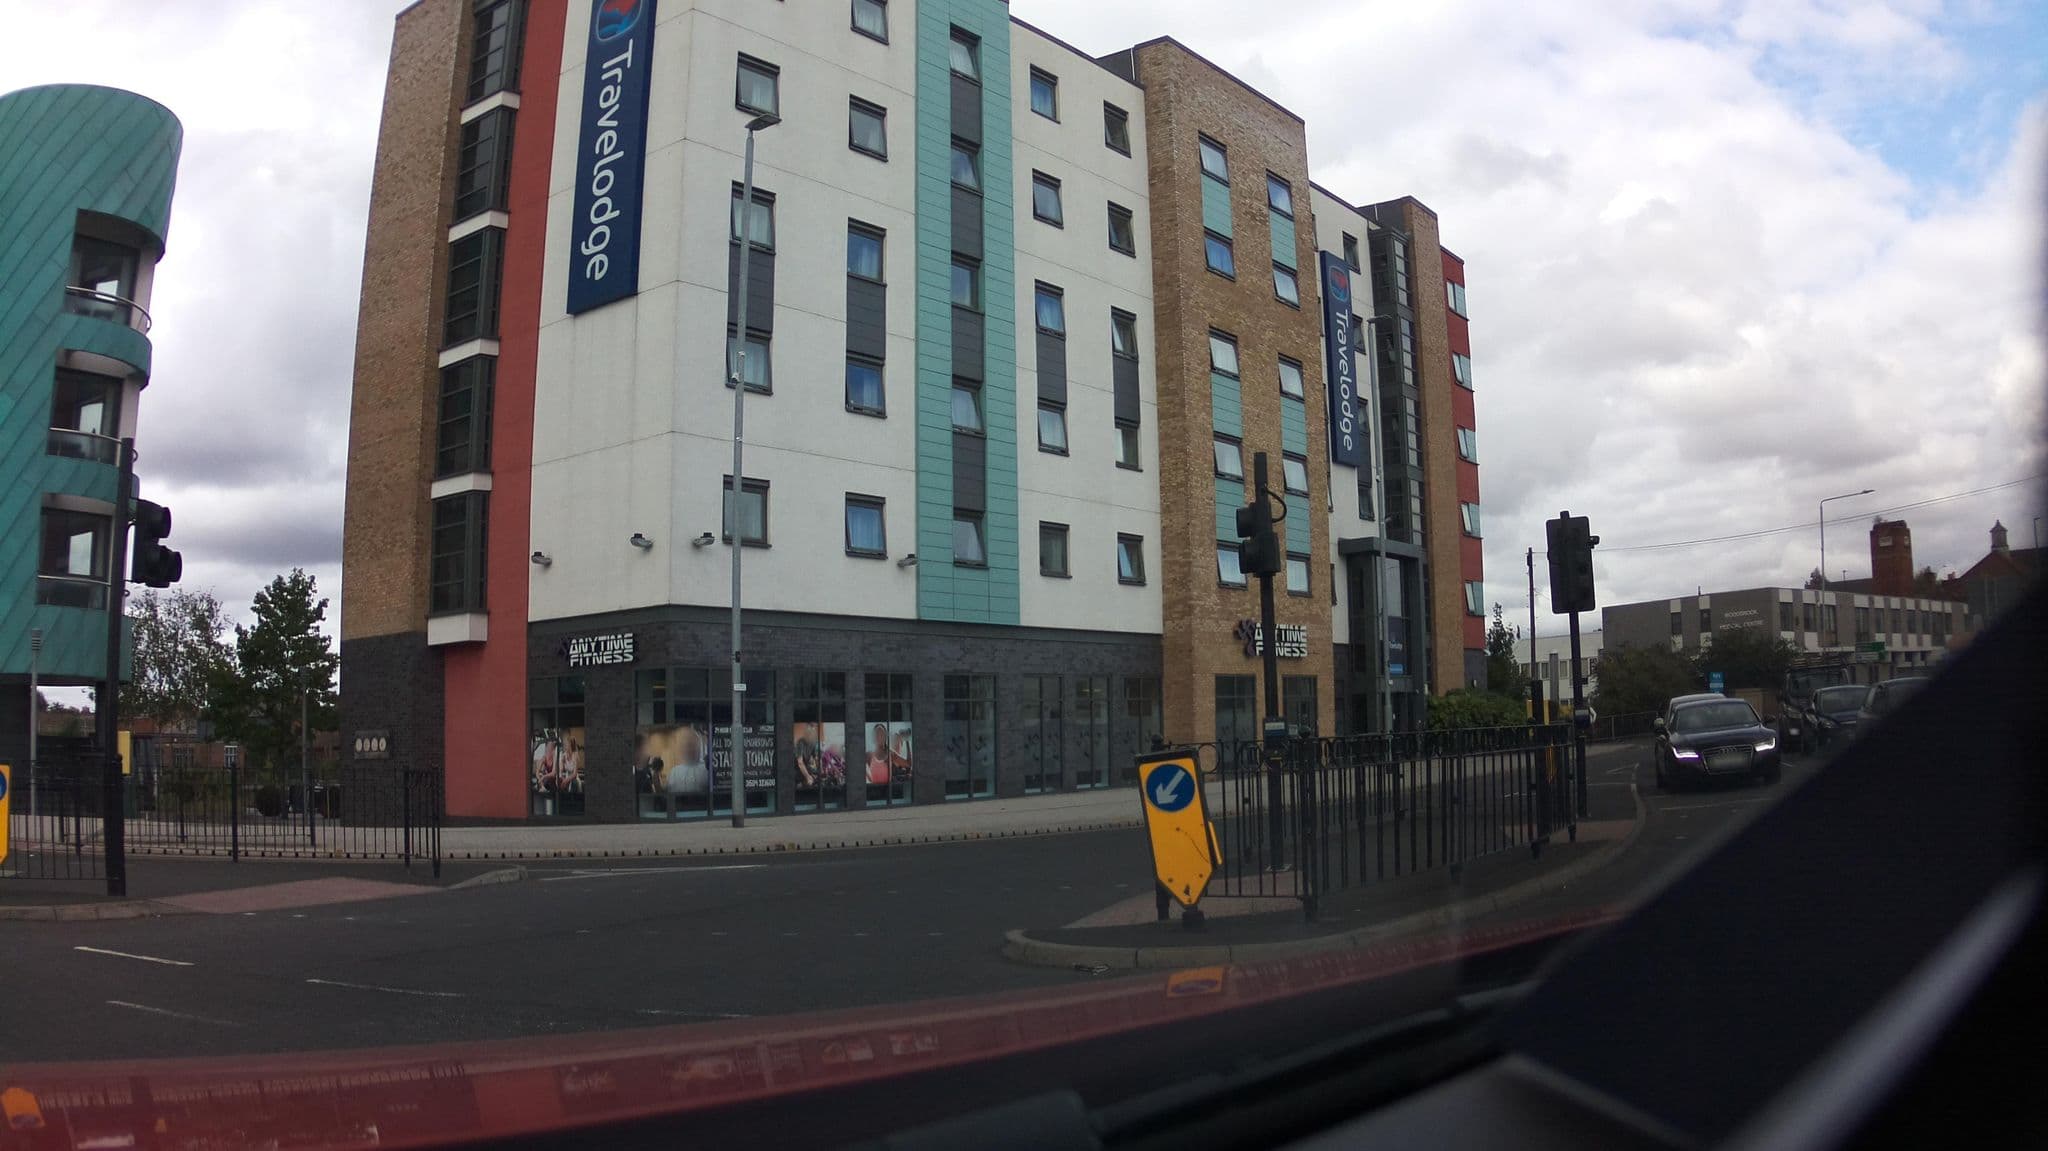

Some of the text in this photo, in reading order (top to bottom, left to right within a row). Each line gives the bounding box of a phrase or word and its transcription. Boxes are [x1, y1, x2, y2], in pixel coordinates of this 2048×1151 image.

[581, 39, 634, 281] Travelodge
[1335, 309, 1354, 452] Travelodge
[569, 633, 634, 655] ANYTIME
[1255, 641, 1308, 656] FNESS
[569, 649, 634, 668] FITNESS
[712, 749, 774, 768] STA TODAY
